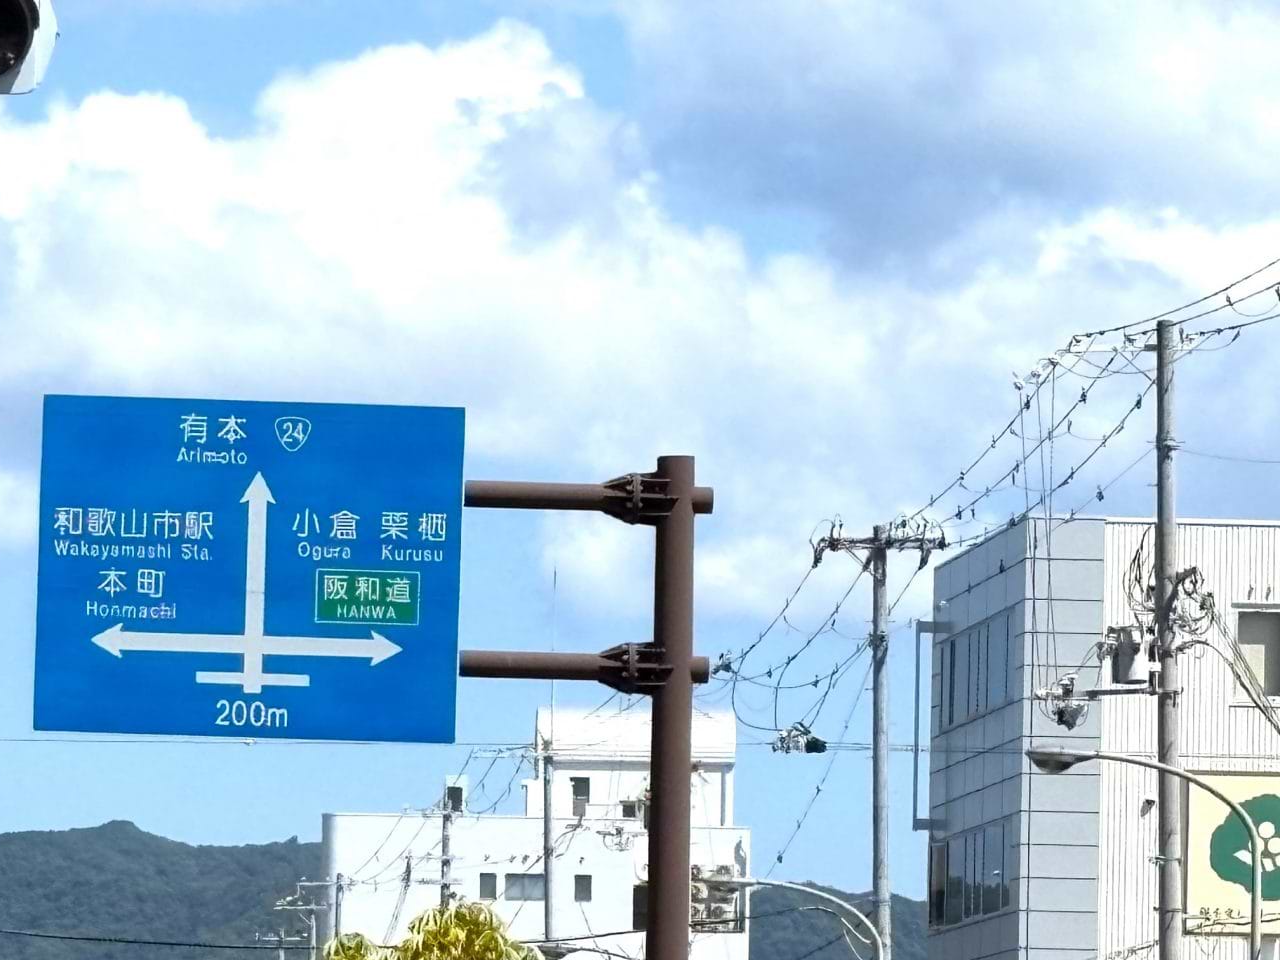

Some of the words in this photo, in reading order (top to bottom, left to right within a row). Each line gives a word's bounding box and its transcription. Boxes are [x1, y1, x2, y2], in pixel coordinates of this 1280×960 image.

[180, 413, 247, 444] 有本
[282, 421, 305, 442] 24
[177, 448, 248, 465] Arimoto
[54, 507, 214, 540] 和歌山市駅
[292, 509, 359, 541] 小倉
[54, 542, 171, 560] Wakayamashi
[180, 544, 214, 561] Sta.
[298, 541, 351, 562] Ogura
[381, 547, 444, 561] Kurusu
[97, 567, 166, 598] 本町
[323, 575, 412, 604] 阪和道
[86, 600, 177, 620] Honmachi
[336, 605, 397, 620] HANWA
[215, 700, 289, 727] 200m
